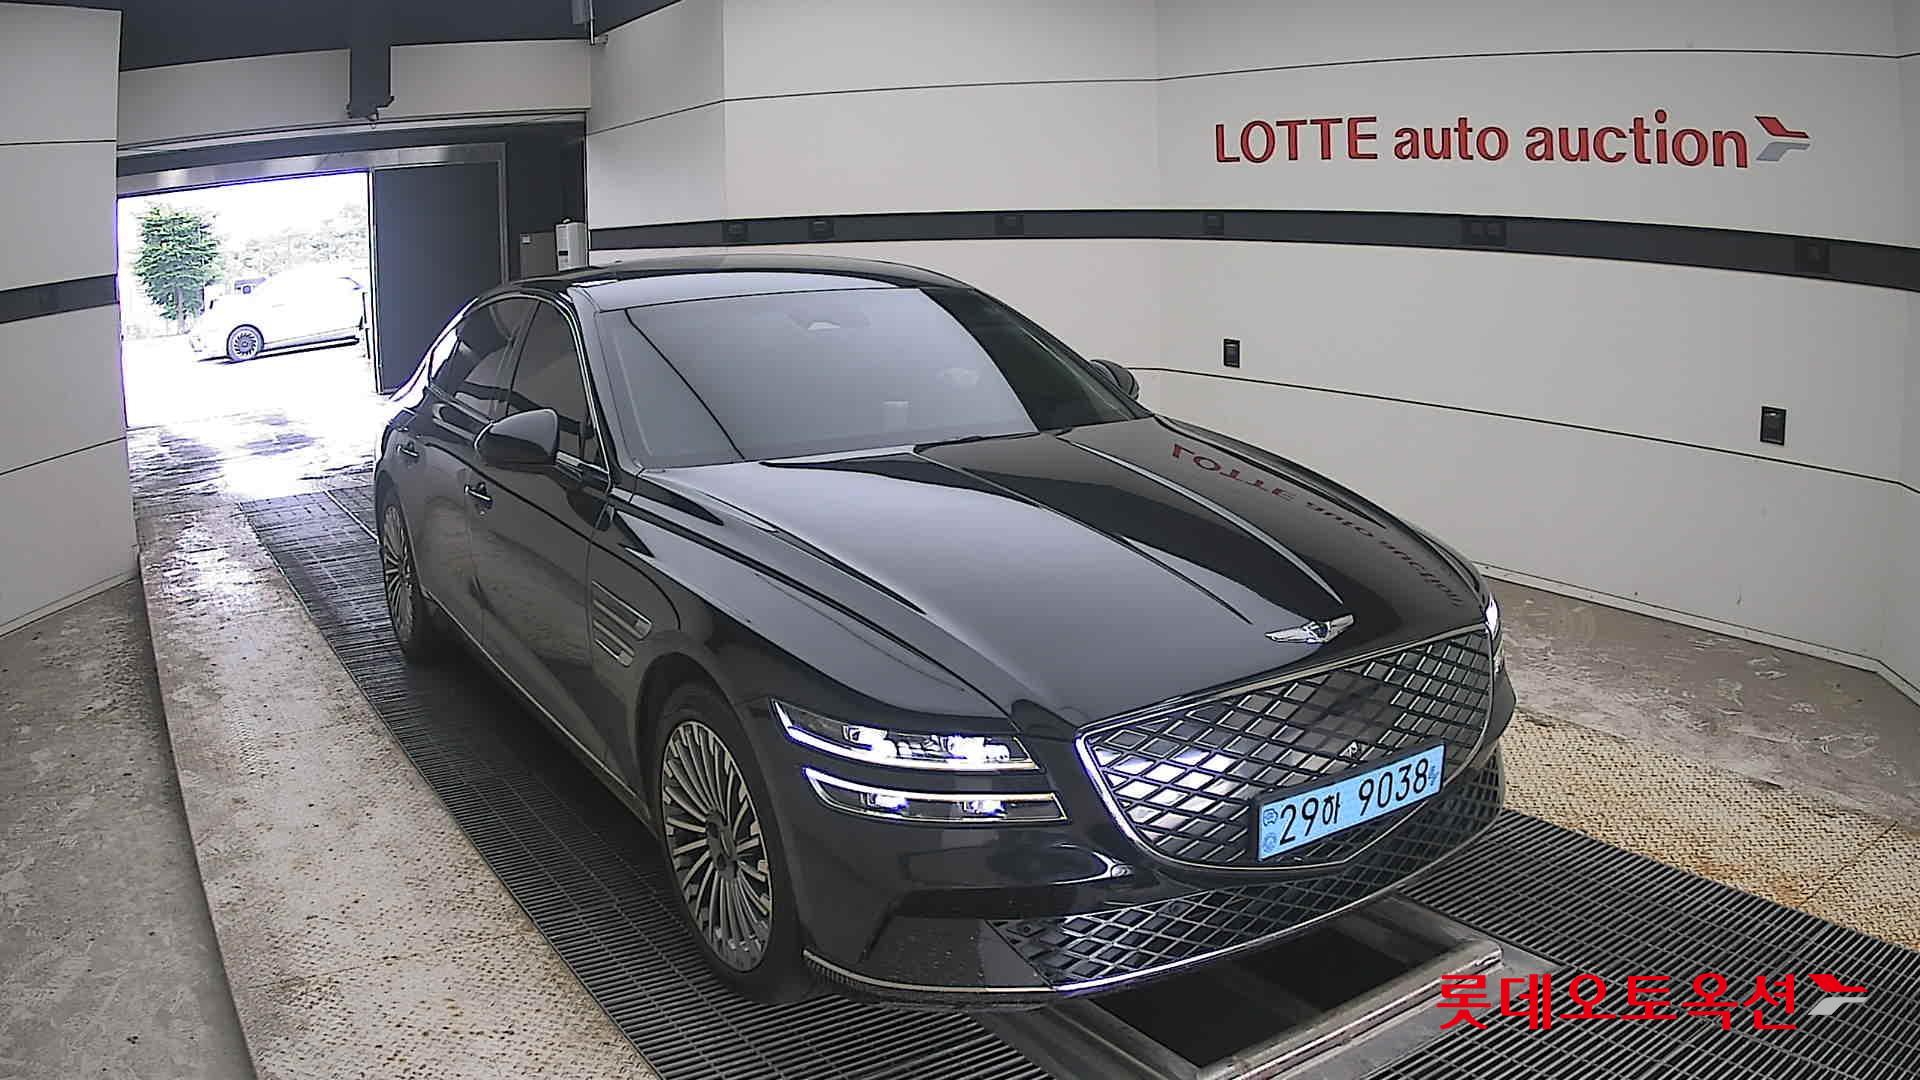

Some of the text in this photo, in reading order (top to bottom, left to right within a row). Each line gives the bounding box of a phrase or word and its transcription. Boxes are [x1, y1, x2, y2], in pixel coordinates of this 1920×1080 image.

[1215, 109, 1748, 168] LOTTE auto auction
[1279, 758, 1430, 846] 29하 9038
